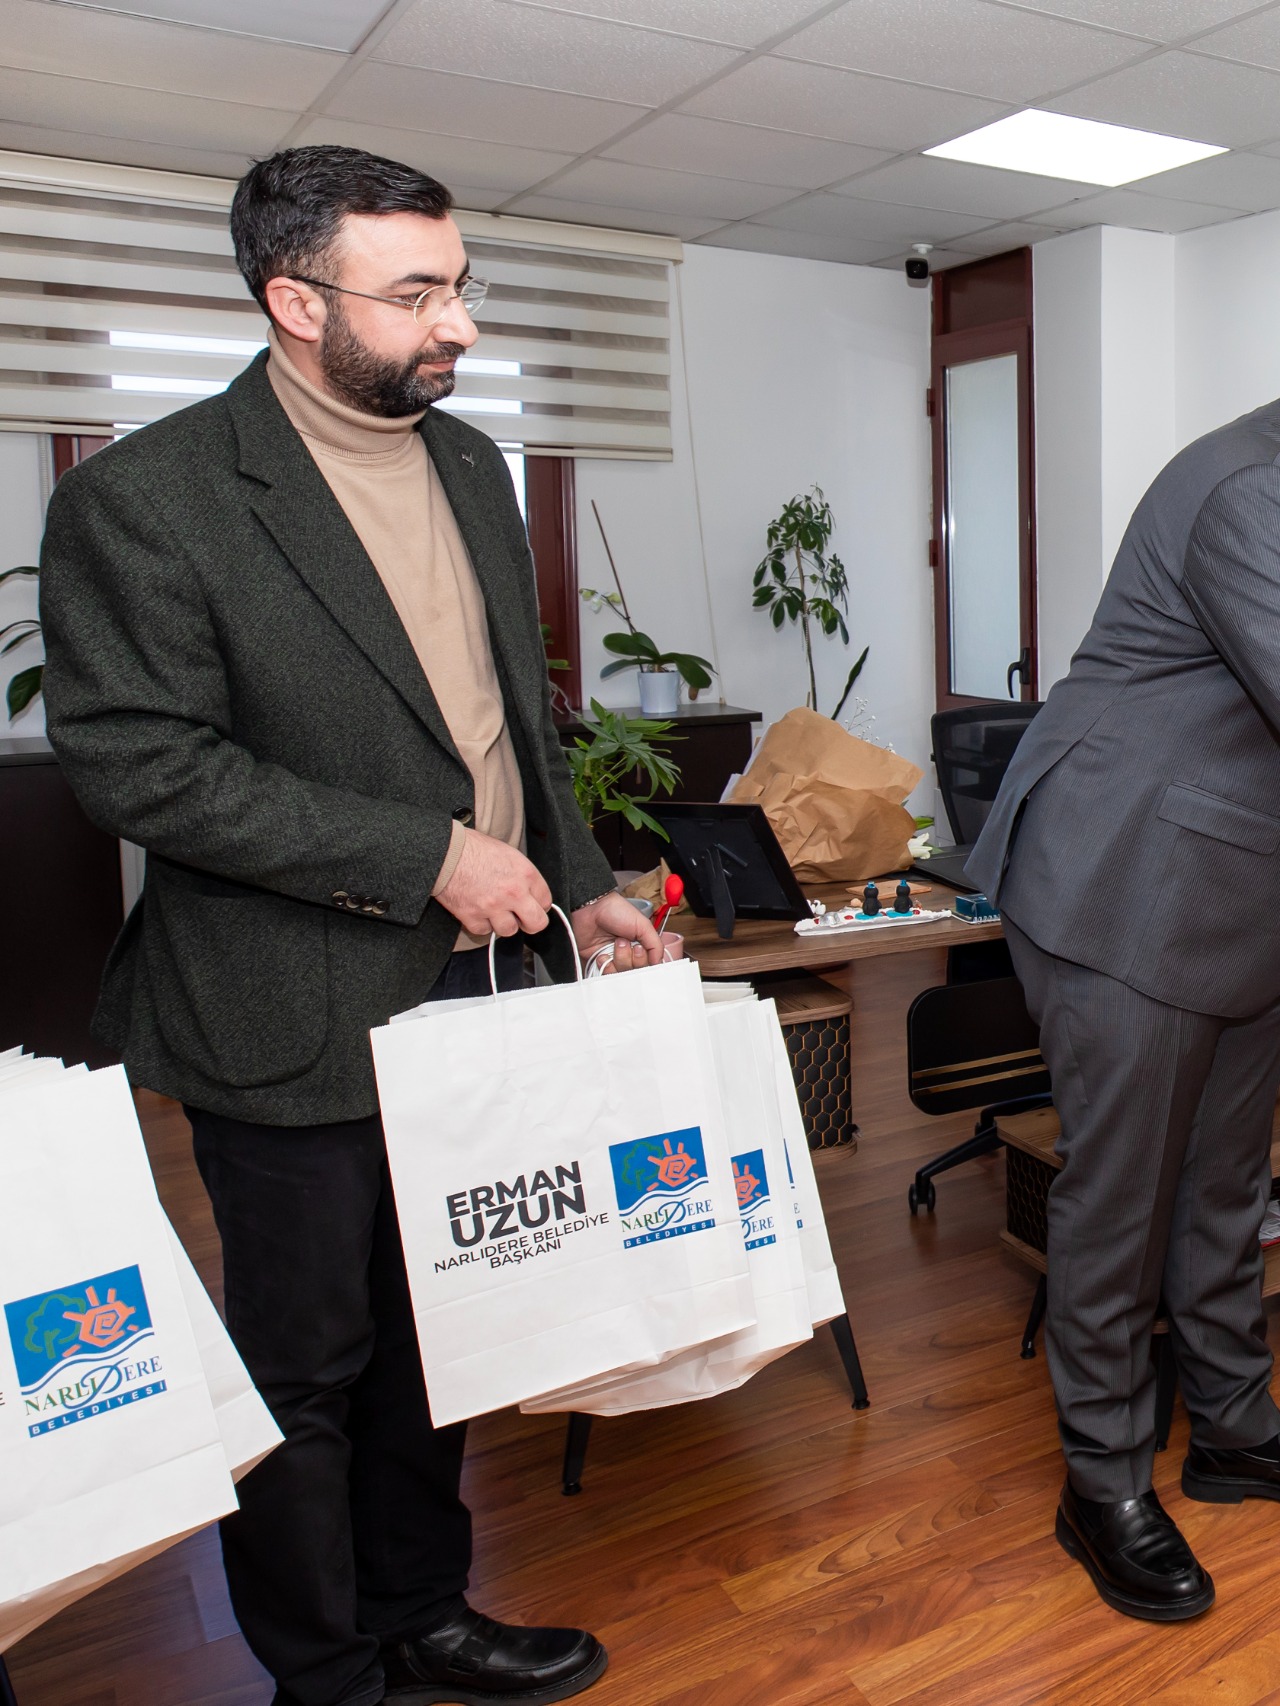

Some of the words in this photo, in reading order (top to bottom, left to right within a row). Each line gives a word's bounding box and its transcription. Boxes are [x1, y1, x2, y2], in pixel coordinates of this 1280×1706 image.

[446, 1160, 582, 1219] ERMAN
[450, 1184, 587, 1248] UZUN
[434, 1235, 529, 1274] NARLIDERE
[533, 1212, 610, 1244] BELEDİYE
[490, 1238, 562, 1269] BAŞKANI
